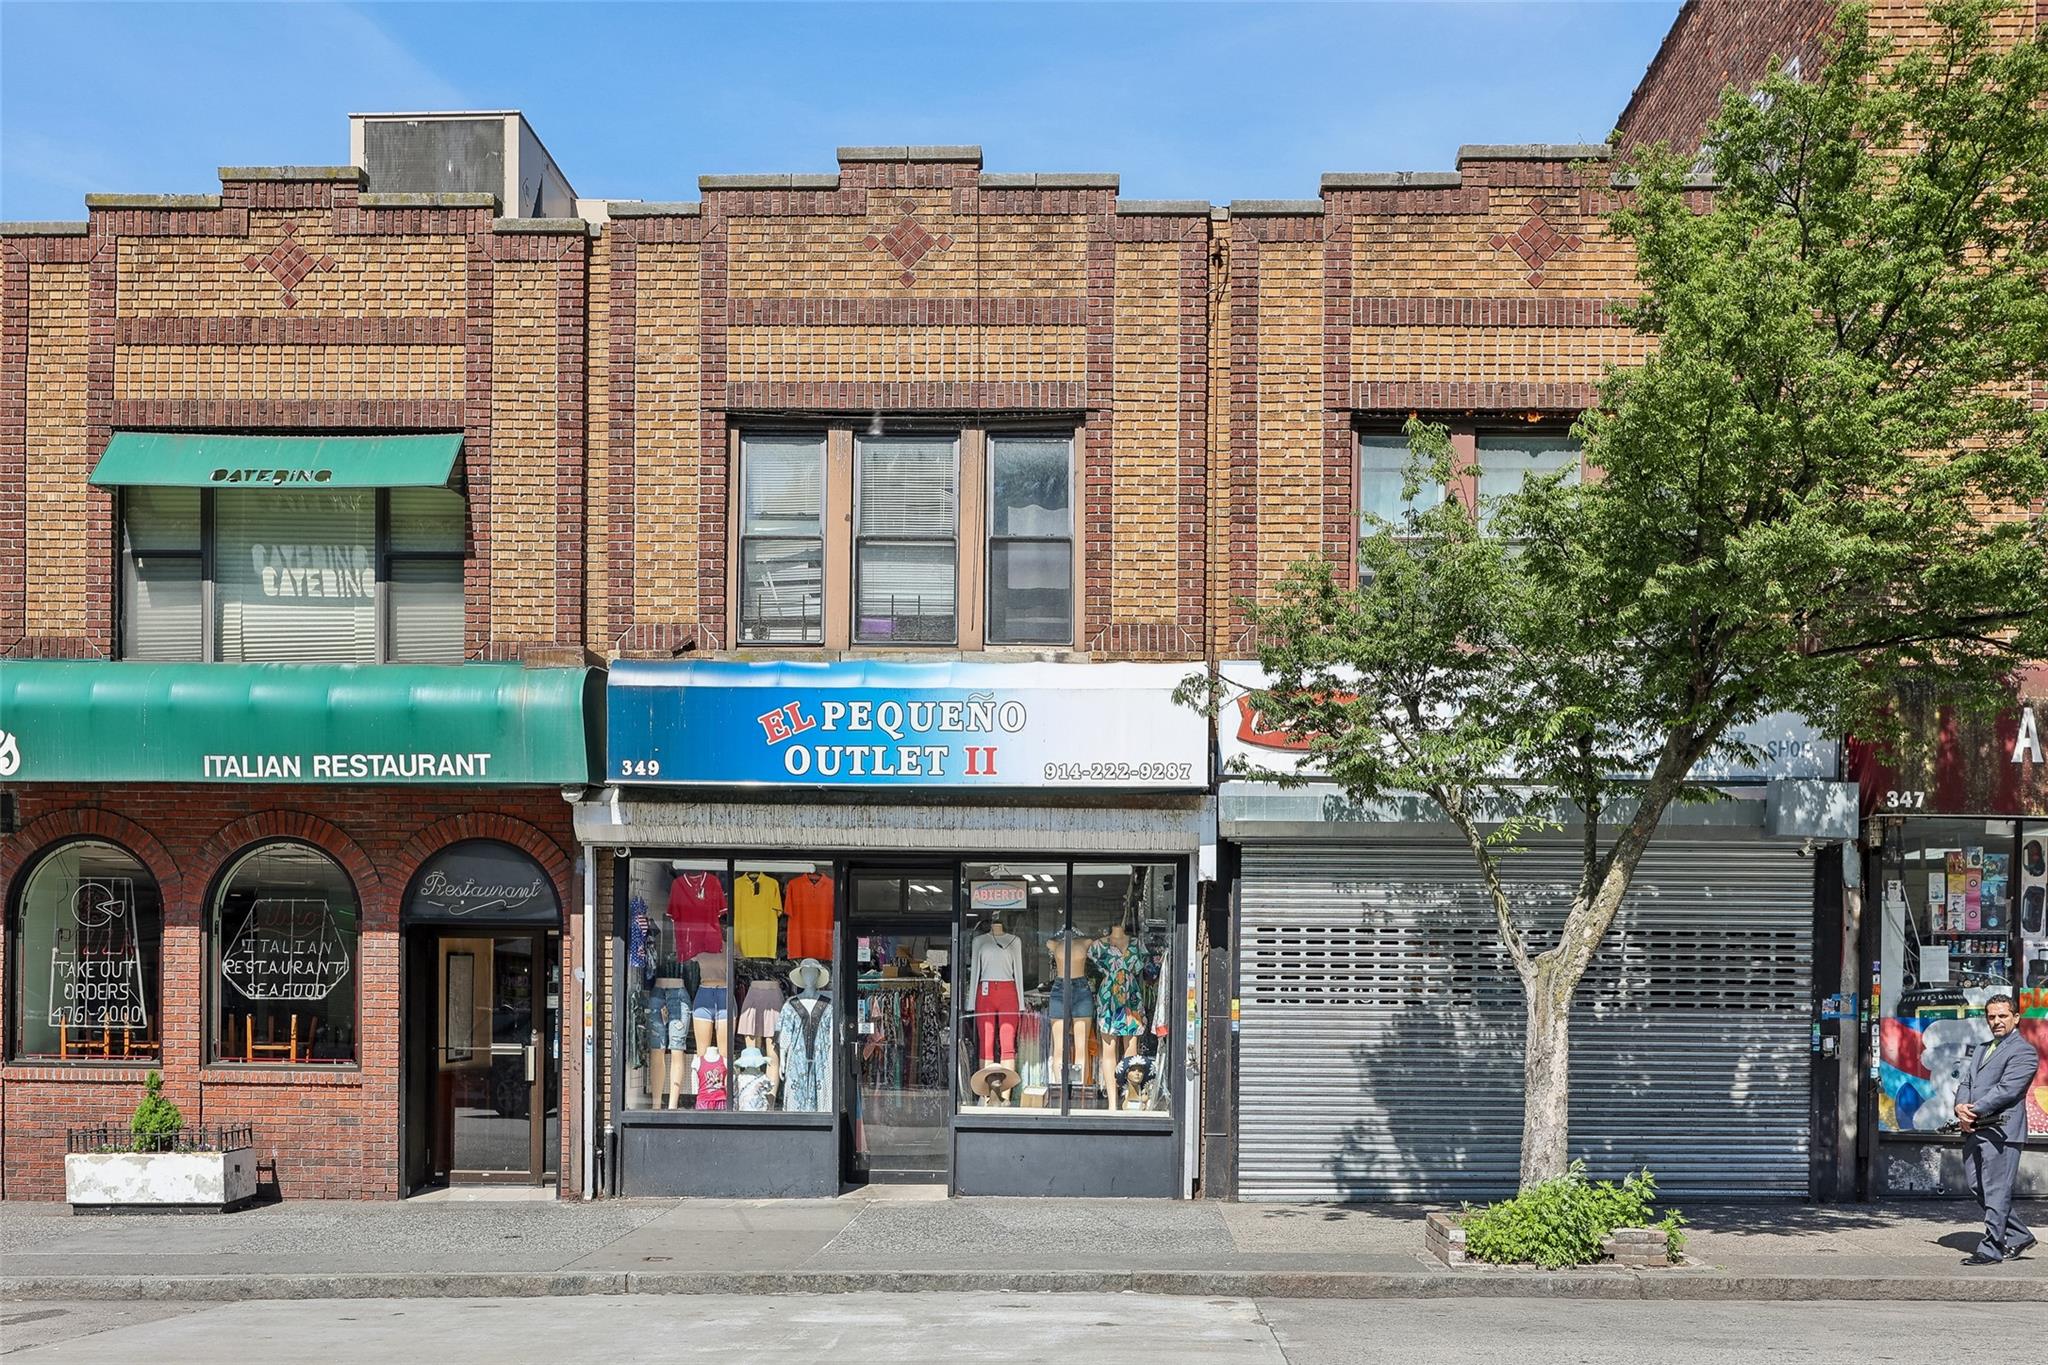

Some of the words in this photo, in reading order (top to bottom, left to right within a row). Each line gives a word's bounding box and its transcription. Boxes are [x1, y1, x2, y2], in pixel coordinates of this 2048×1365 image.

[757, 700, 816, 745] EL
[821, 691, 1027, 741] PEQUEÑO
[203, 755, 300, 778] ITALIAN
[313, 753, 492, 778] RESTAURANT
[621, 759, 660, 776] 349
[783, 744, 950, 777] OUTLET
[964, 746, 998, 776] II
[1044, 762, 1193, 780] 914-222-9287
[1886, 790, 1925, 808] 347
[420, 871, 542, 898] Restaurant
[974, 889, 1025, 900] ABIERTO
[242, 939, 332, 954] ITALIAN
[58, 961, 96, 978] TAKE
[100, 961, 132, 978] OUT
[224, 960, 345, 975] RESTAURANT
[64, 982, 130, 1001] ORDERS
[246, 983, 326, 998] SEAFOOD
[52, 1005, 141, 1023] 476-2000
